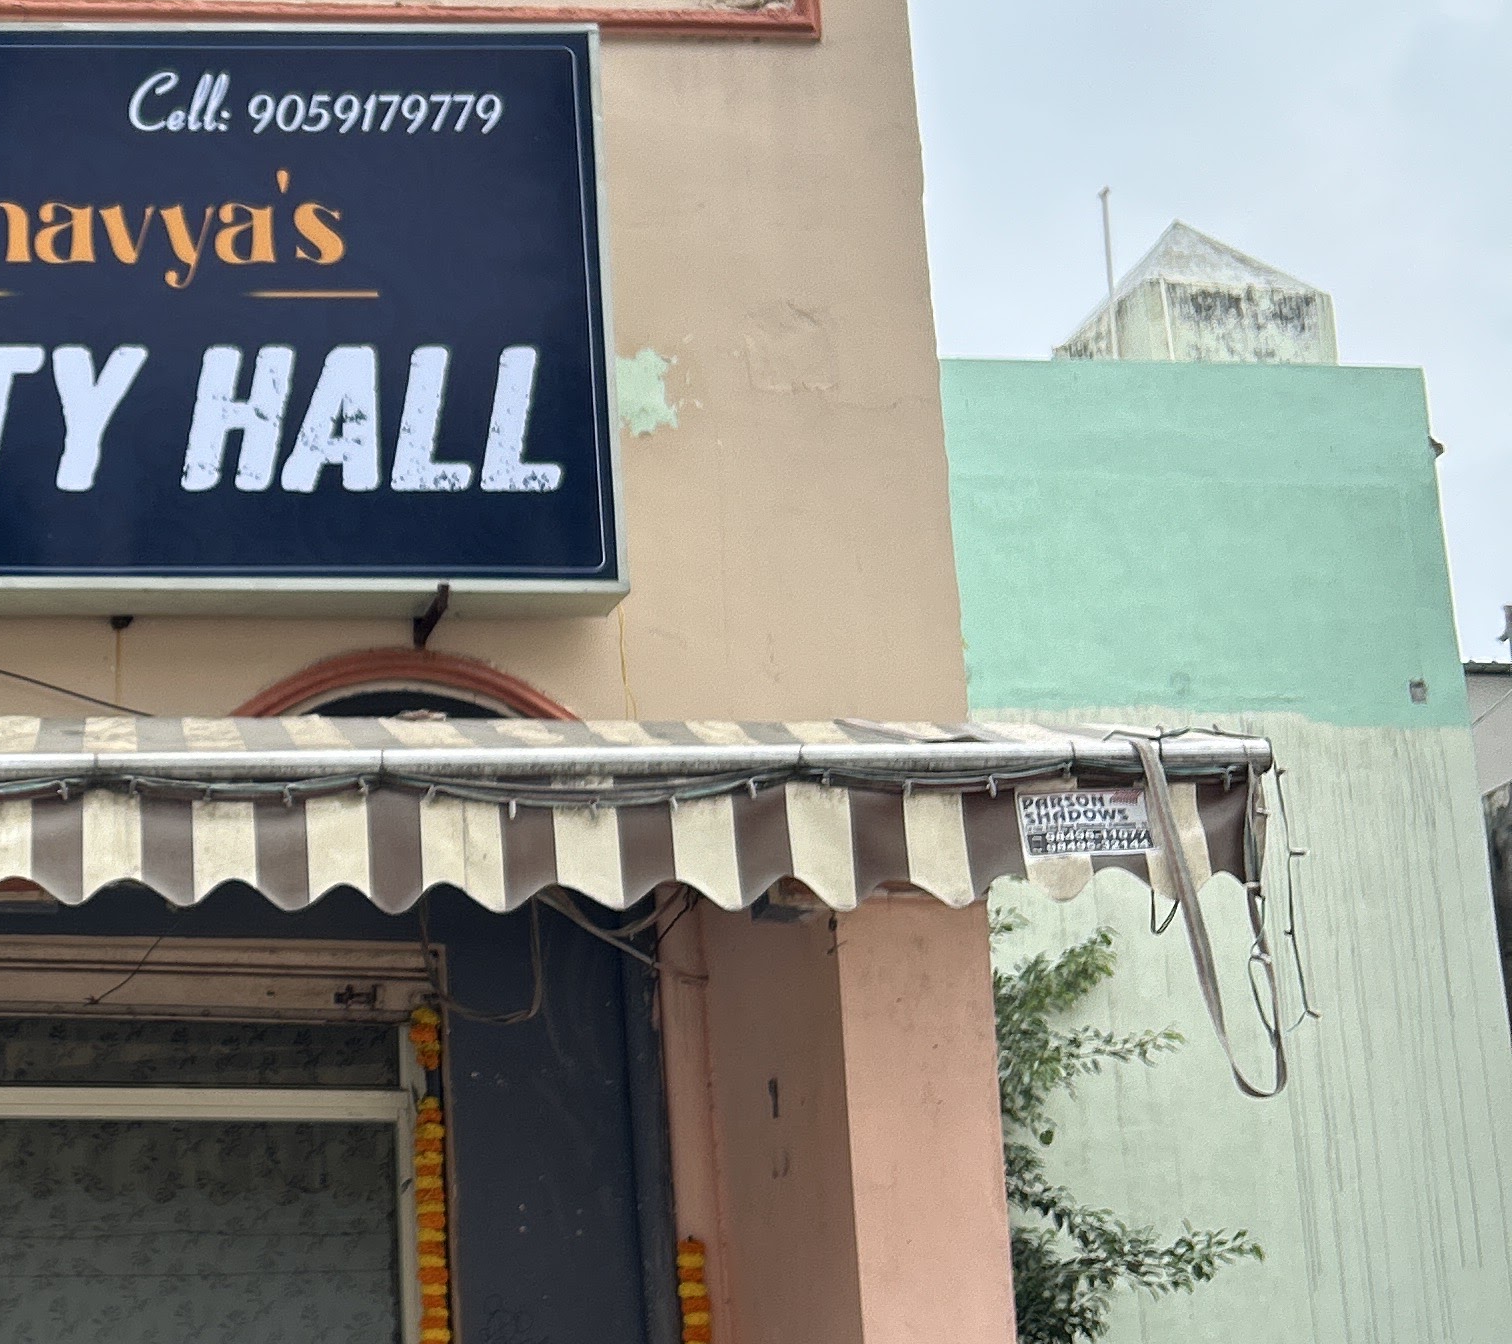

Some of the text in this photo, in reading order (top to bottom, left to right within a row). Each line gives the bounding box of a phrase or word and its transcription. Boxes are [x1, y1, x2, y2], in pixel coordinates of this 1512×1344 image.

[128, 70, 504, 135] Cell: 9059179779
[180, 345, 563, 493] HALL
[1022, 794, 1105, 810] PARSON
[1023, 808, 1129, 824] SHADOWS
